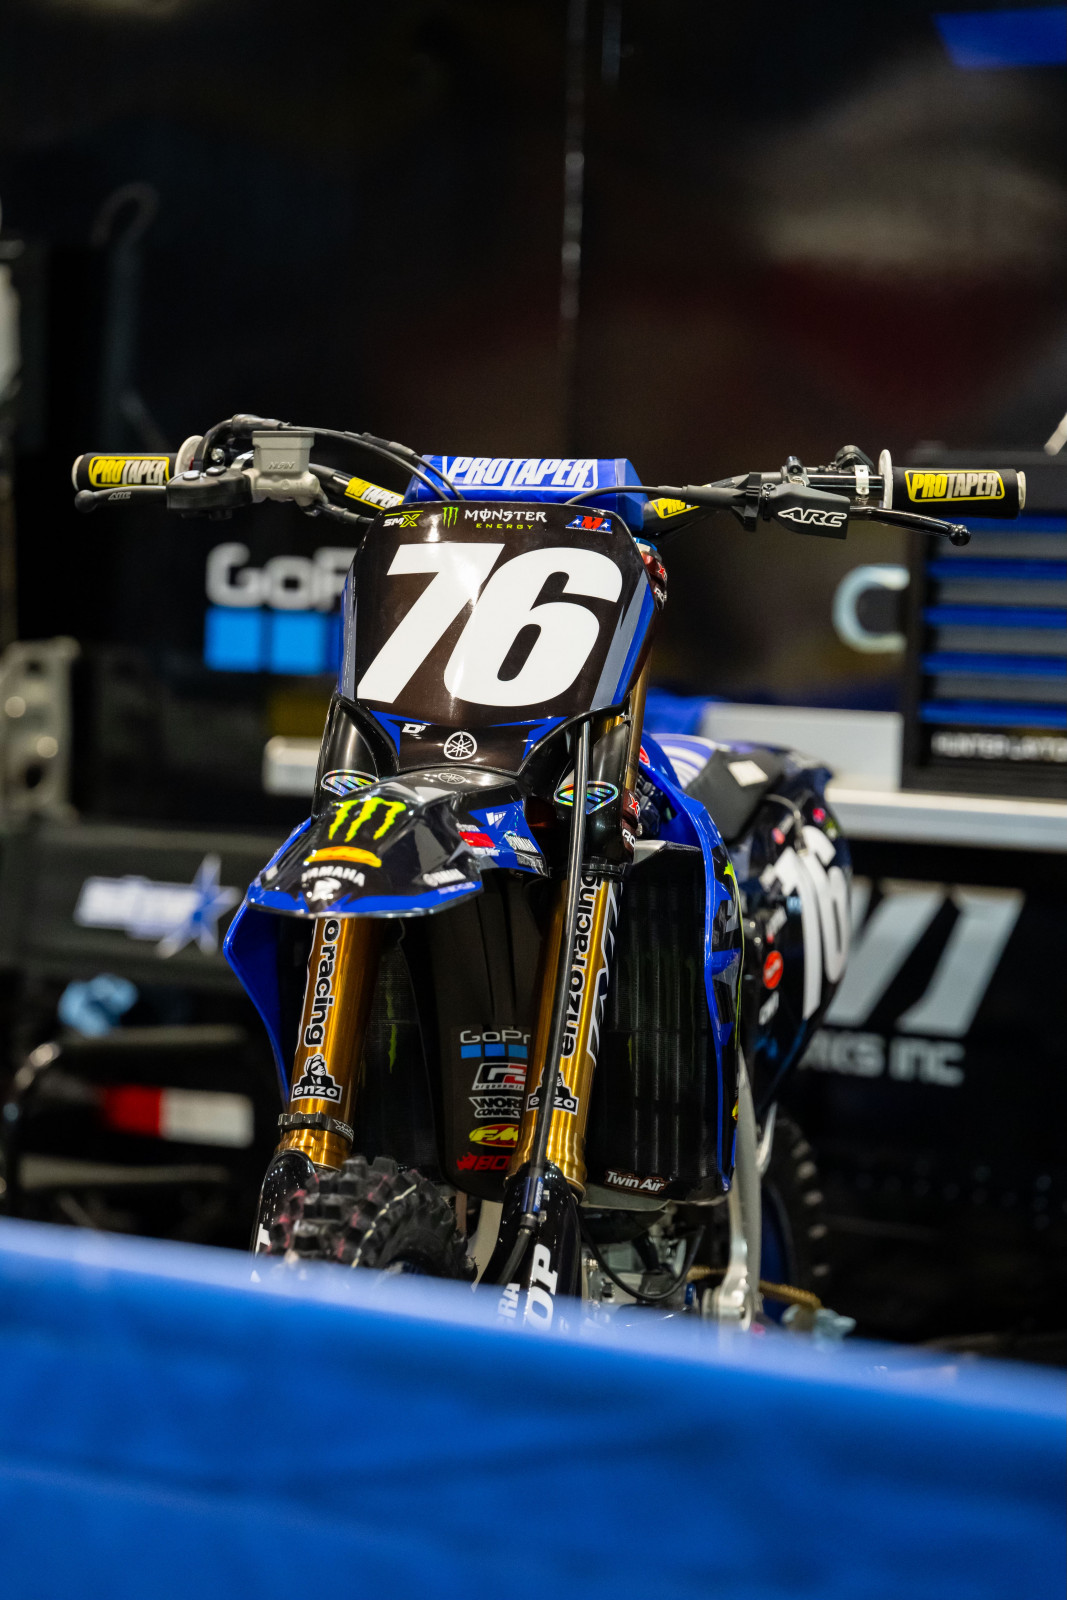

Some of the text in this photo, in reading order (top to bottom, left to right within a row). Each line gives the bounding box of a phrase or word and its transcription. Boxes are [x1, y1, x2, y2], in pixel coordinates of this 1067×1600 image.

[92, 459, 167, 486] PROTAPER
[448, 457, 591, 491] PROTAPER
[911, 472, 999, 498] PROTAPER
[464, 508, 548, 523] MONSTER
[657, 498, 691, 517] PRO
[777, 507, 848, 528] ARC
[383, 513, 421, 528] SMX
[205, 541, 357, 612] GoP
[357, 543, 623, 707] 76
[460, 1030, 531, 1044] GoPr
[294, 1085, 338, 1098] enzo
[529, 1096, 575, 1109] ezo
[469, 1126, 519, 1142] FM
[607, 1171, 665, 1192] Twin Air
